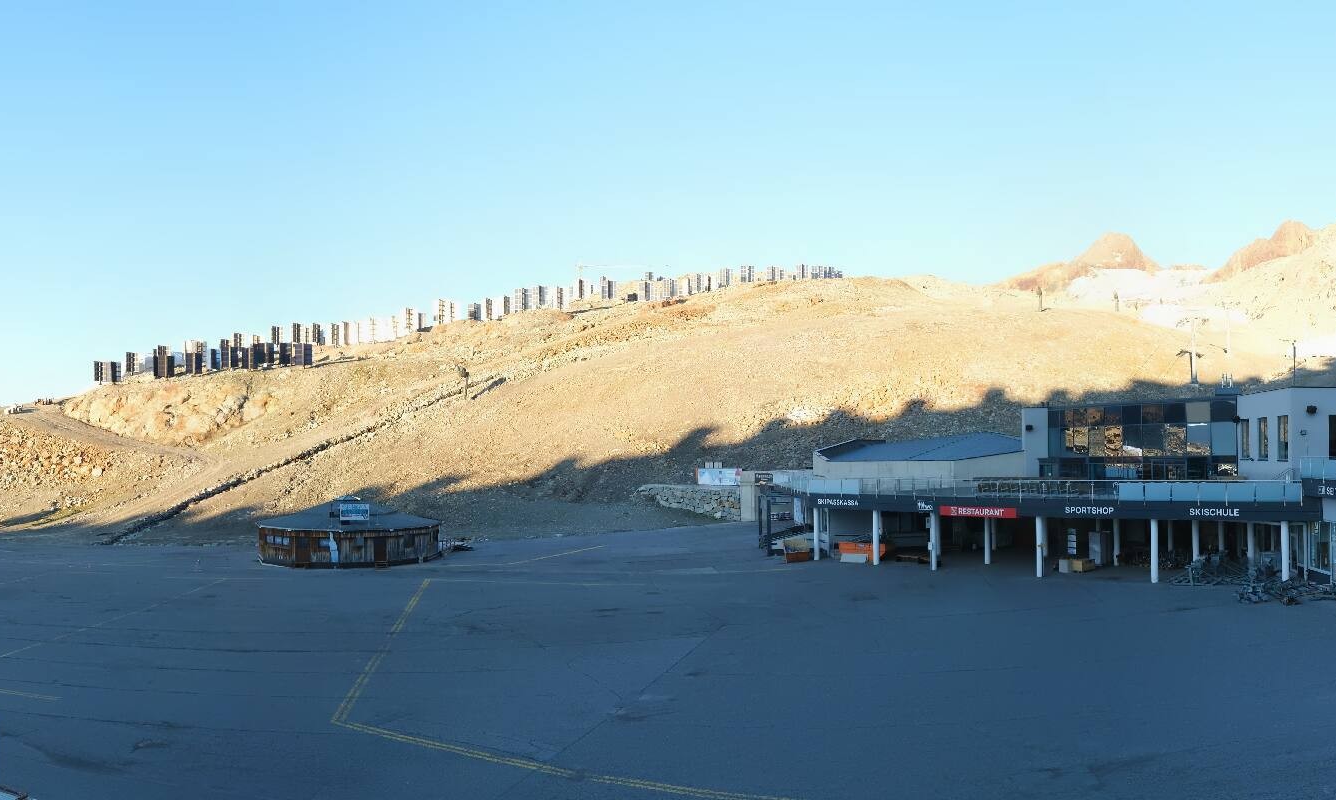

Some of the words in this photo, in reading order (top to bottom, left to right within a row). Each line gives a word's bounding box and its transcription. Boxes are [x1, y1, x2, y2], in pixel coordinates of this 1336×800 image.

[817, 498, 859, 506] SKIPASSKASSA
[958, 507, 1004, 517] RESTAURANT
[1065, 506, 1114, 515] SPORTSHOP
[1189, 508, 1240, 517] SKISCHULE
